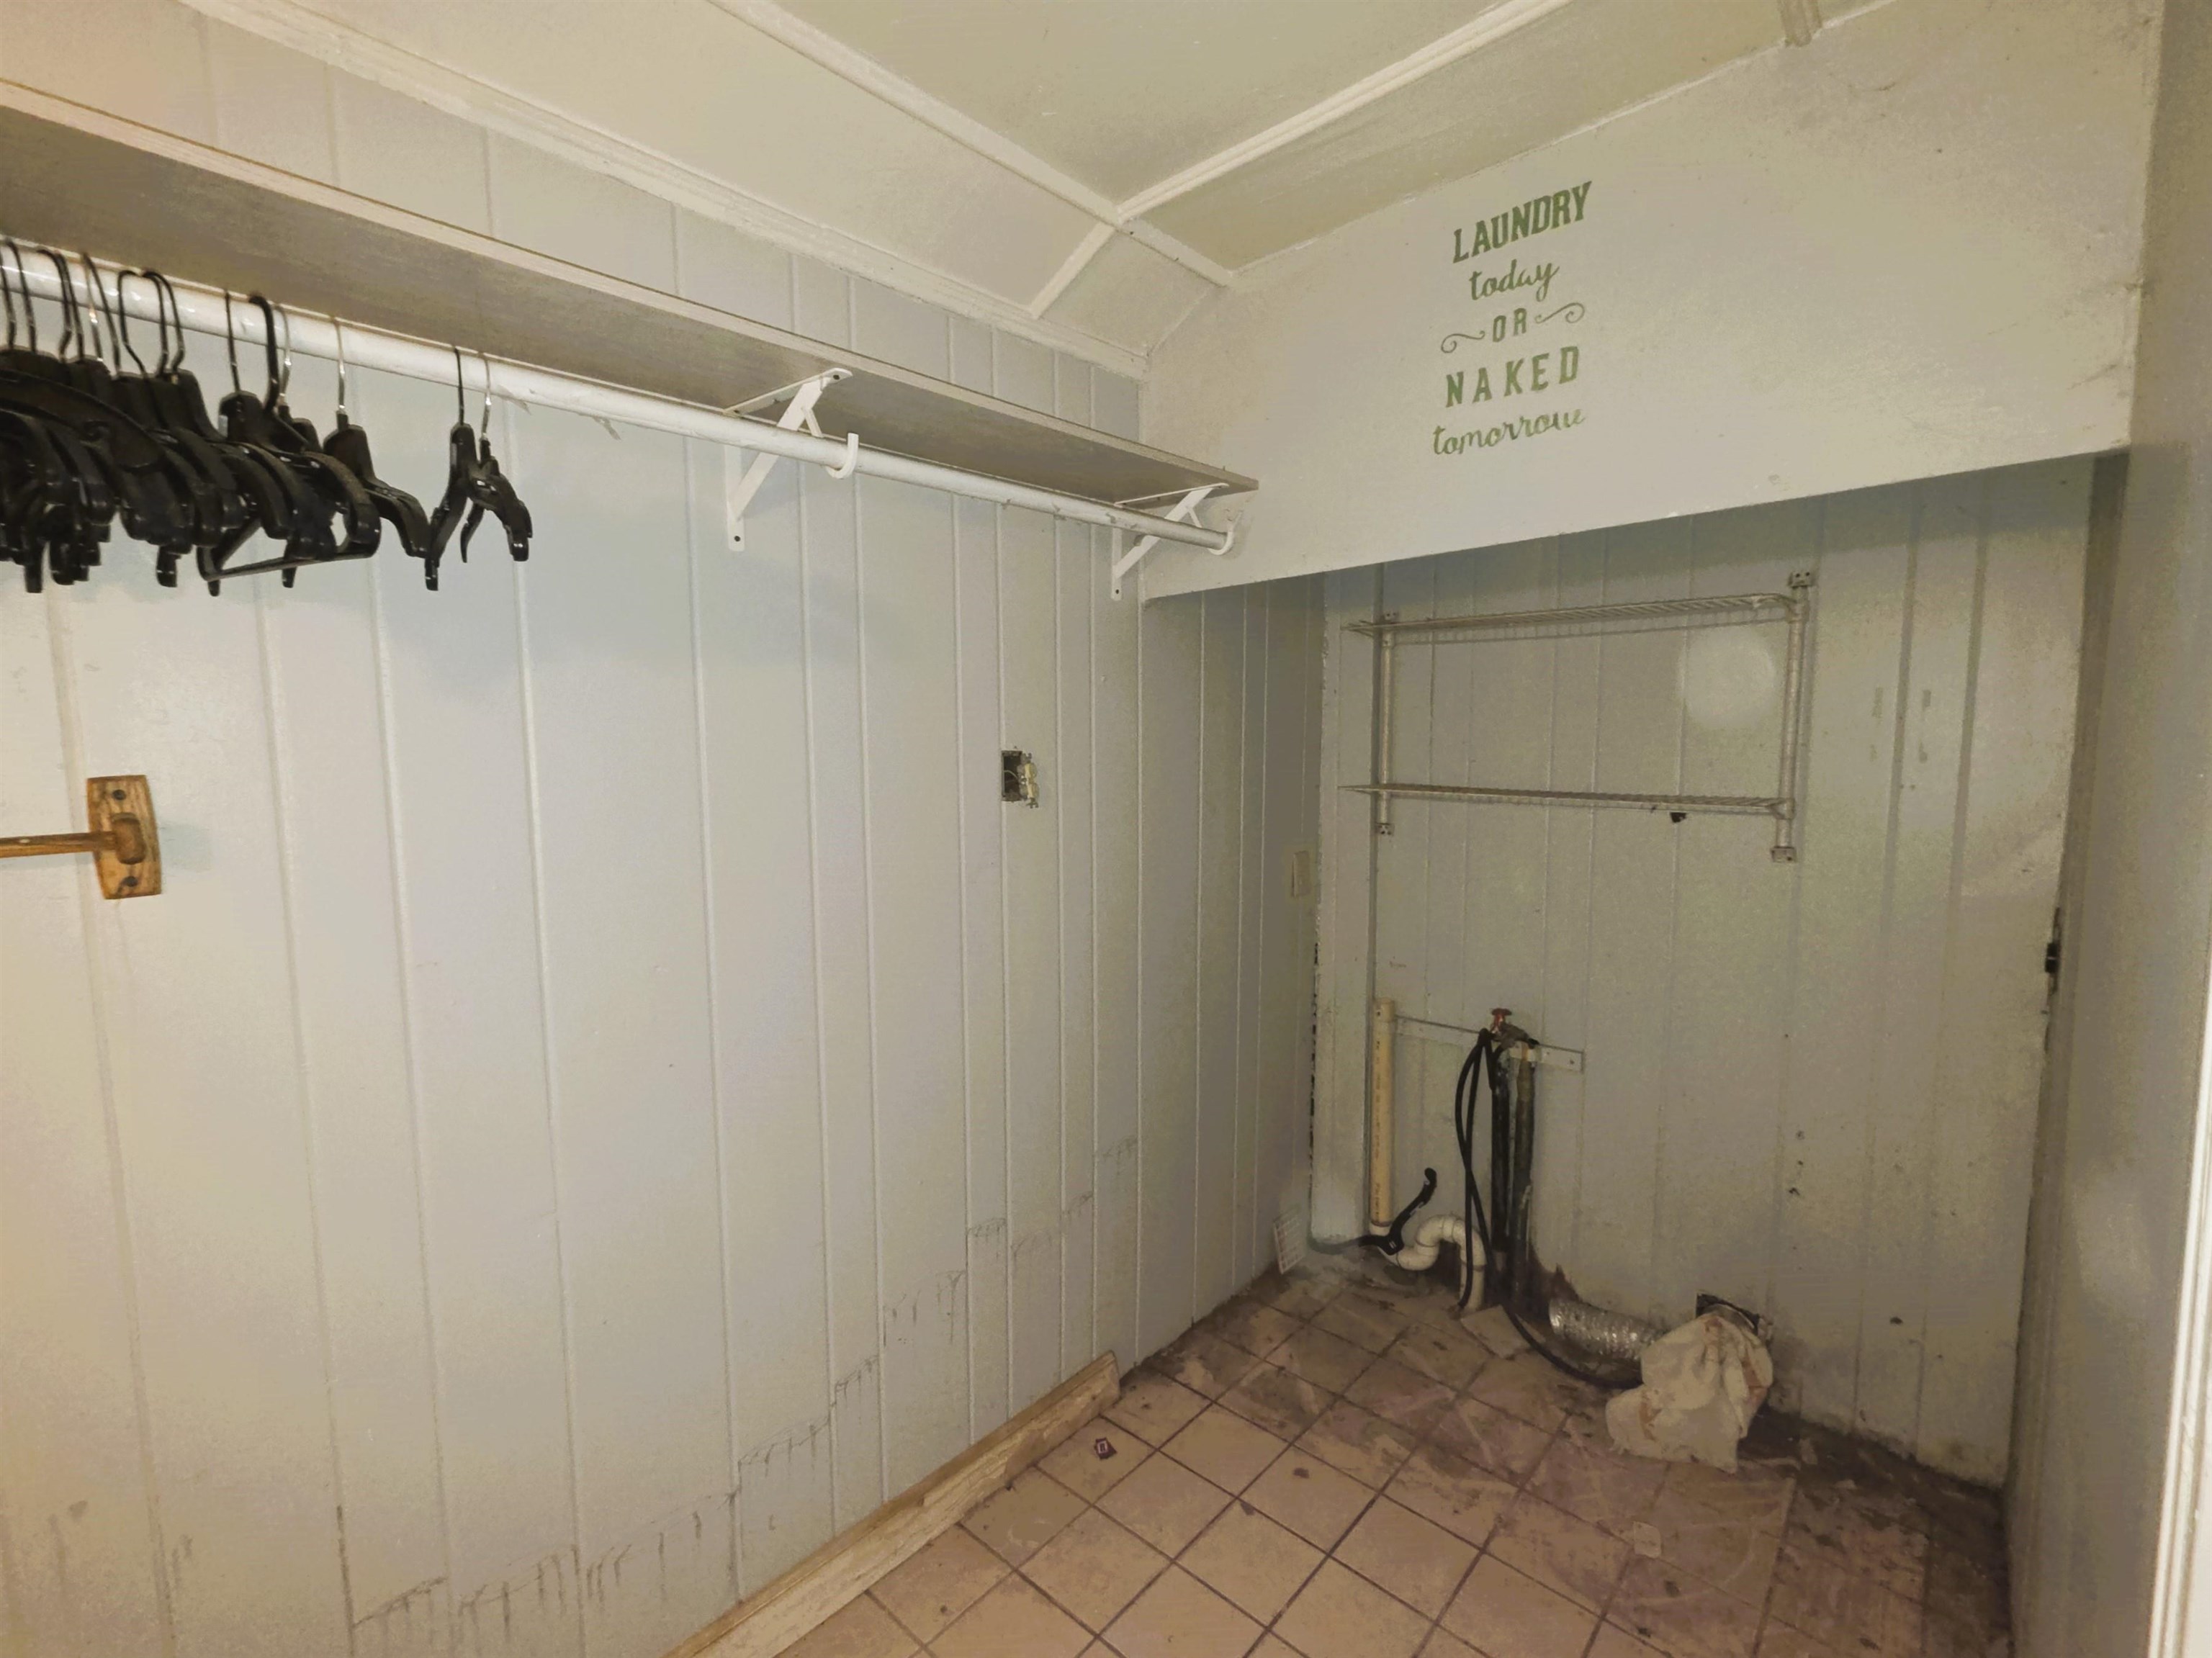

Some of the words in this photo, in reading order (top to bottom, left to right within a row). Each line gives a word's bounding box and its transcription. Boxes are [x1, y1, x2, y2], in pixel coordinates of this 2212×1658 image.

[1453, 181, 1592, 263] LAUNDRY
[1469, 259, 1560, 302] today
[1492, 307, 1527, 343] OR
[1446, 346, 1579, 407] NAKED
[1433, 408, 1586, 455] tomorrow
